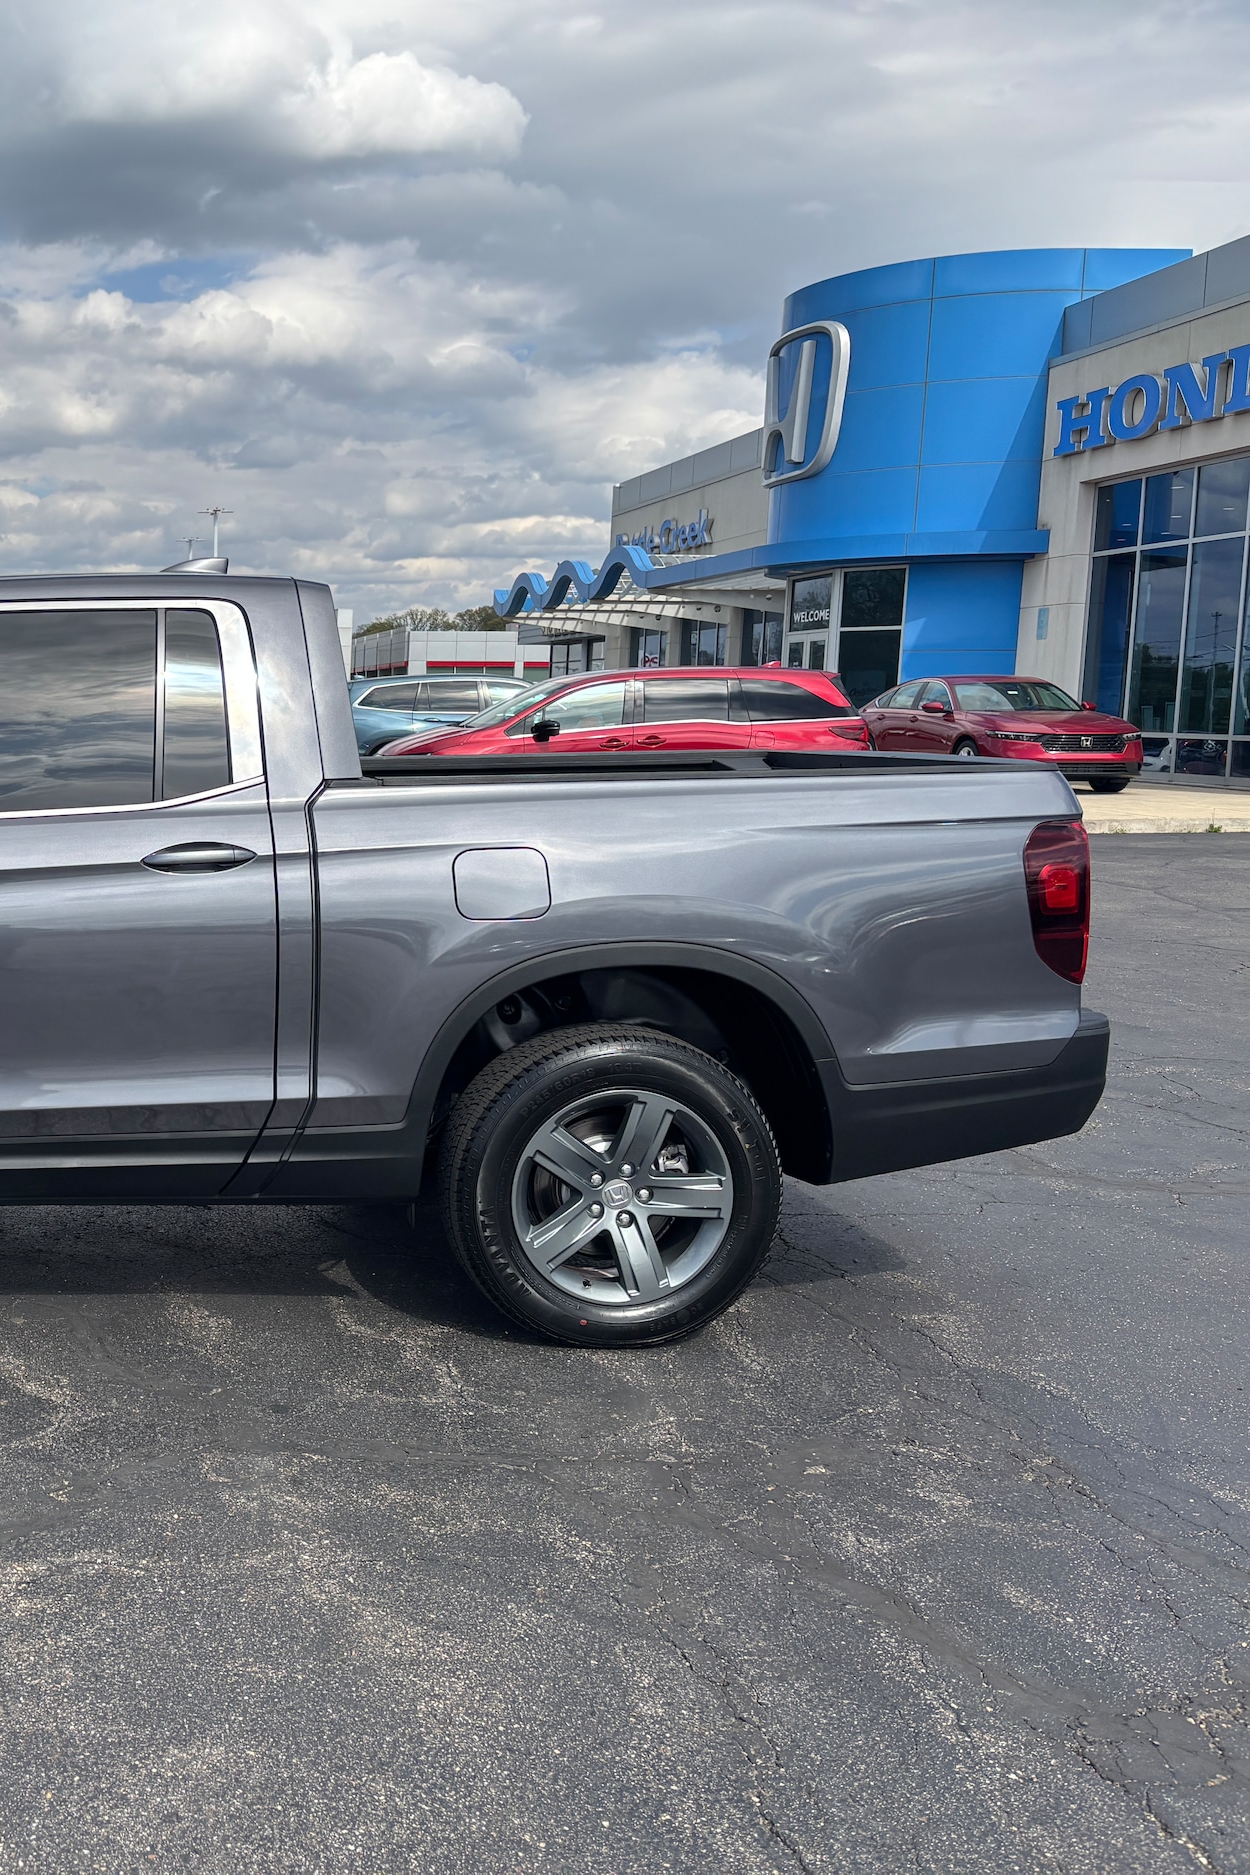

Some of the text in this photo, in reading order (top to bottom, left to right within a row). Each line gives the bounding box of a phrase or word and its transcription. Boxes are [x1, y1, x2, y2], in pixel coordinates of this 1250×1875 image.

[660, 508, 713, 554] Creek
[793, 608, 830, 623] WELCOME
[480, 1205, 532, 1297] ADVANTA
